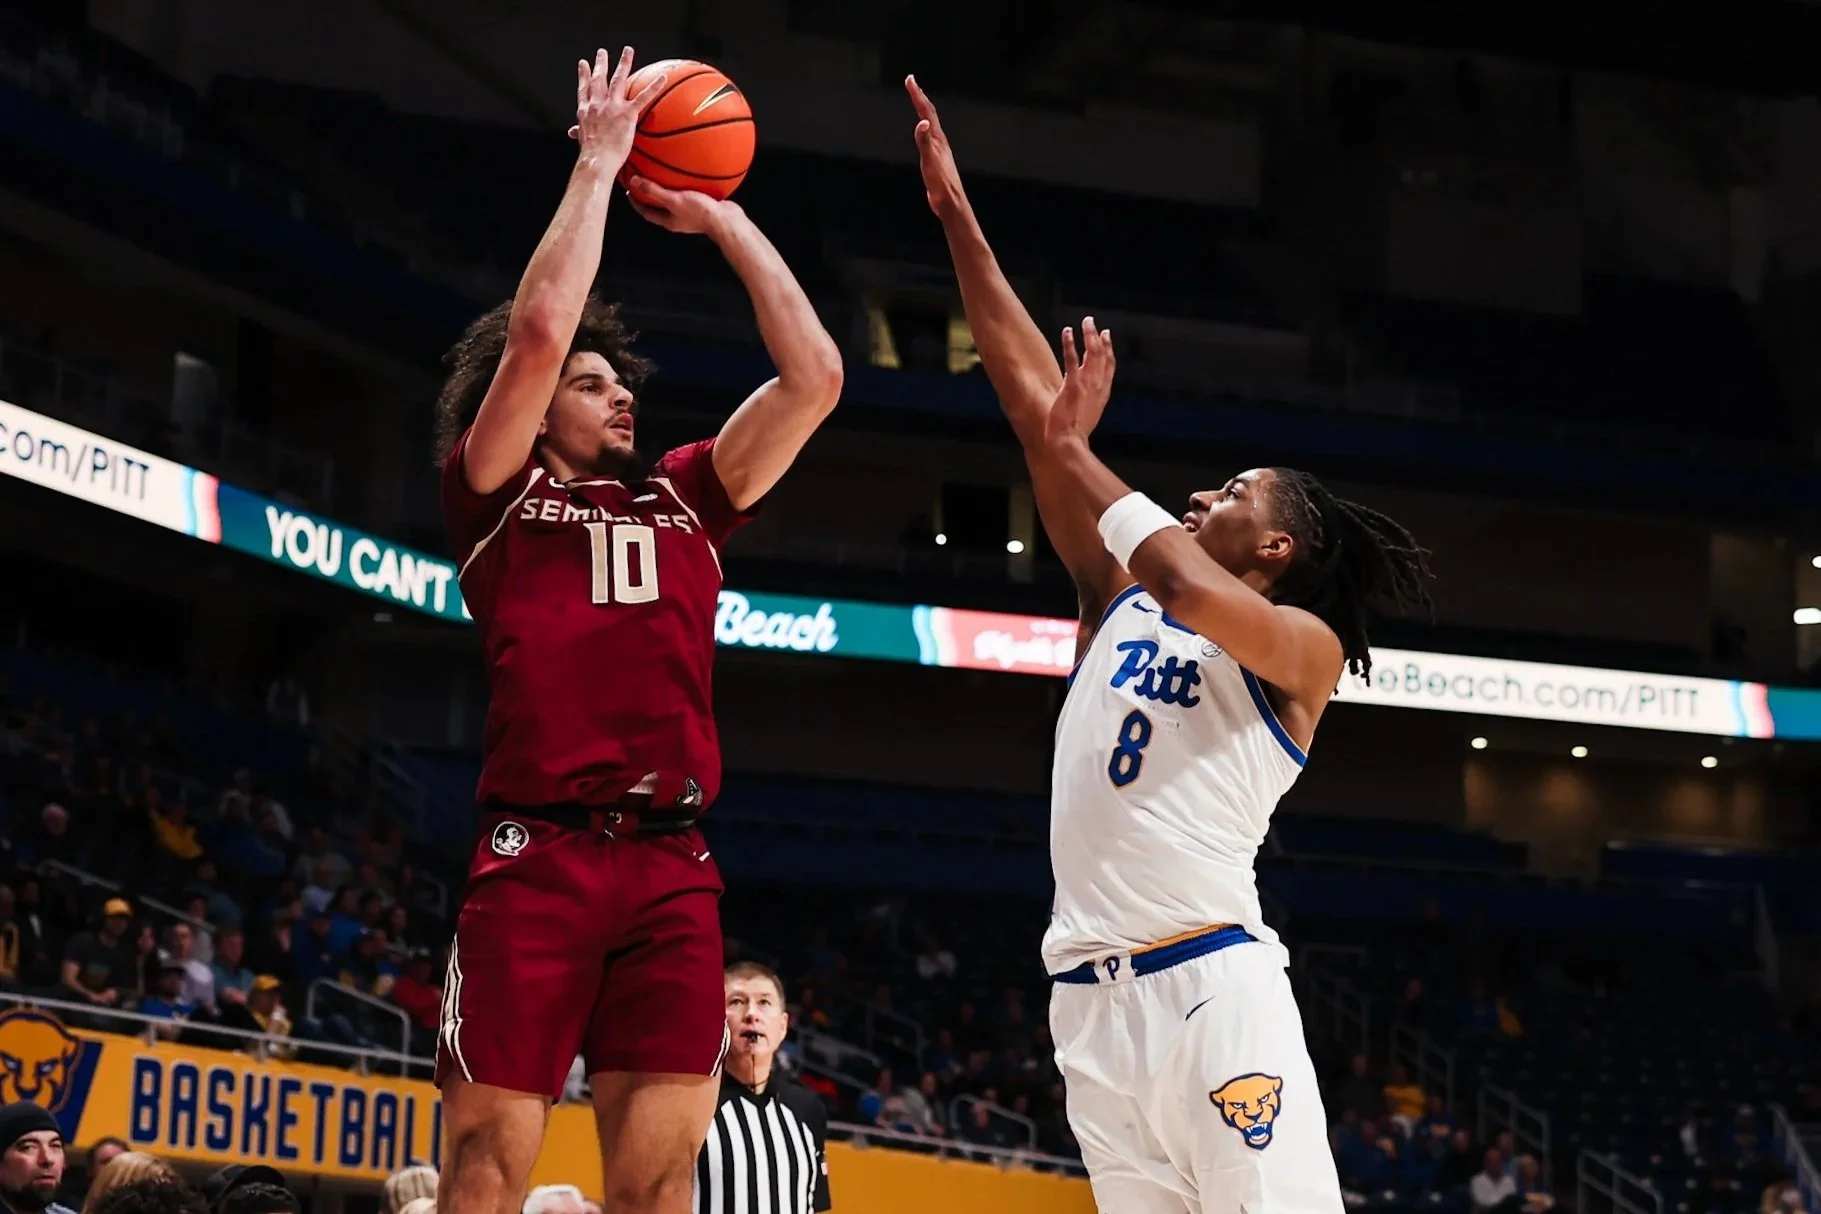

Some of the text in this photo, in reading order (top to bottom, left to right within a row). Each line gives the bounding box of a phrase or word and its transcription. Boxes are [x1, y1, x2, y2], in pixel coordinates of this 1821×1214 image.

[520, 498, 693, 534] SEMINES
[265, 506, 453, 613] YOU CAN'T
[583, 522, 659, 604] 10
[714, 590, 838, 652] Beach
[1110, 639, 1201, 708] Pitt
[1108, 708, 1153, 789] 8
